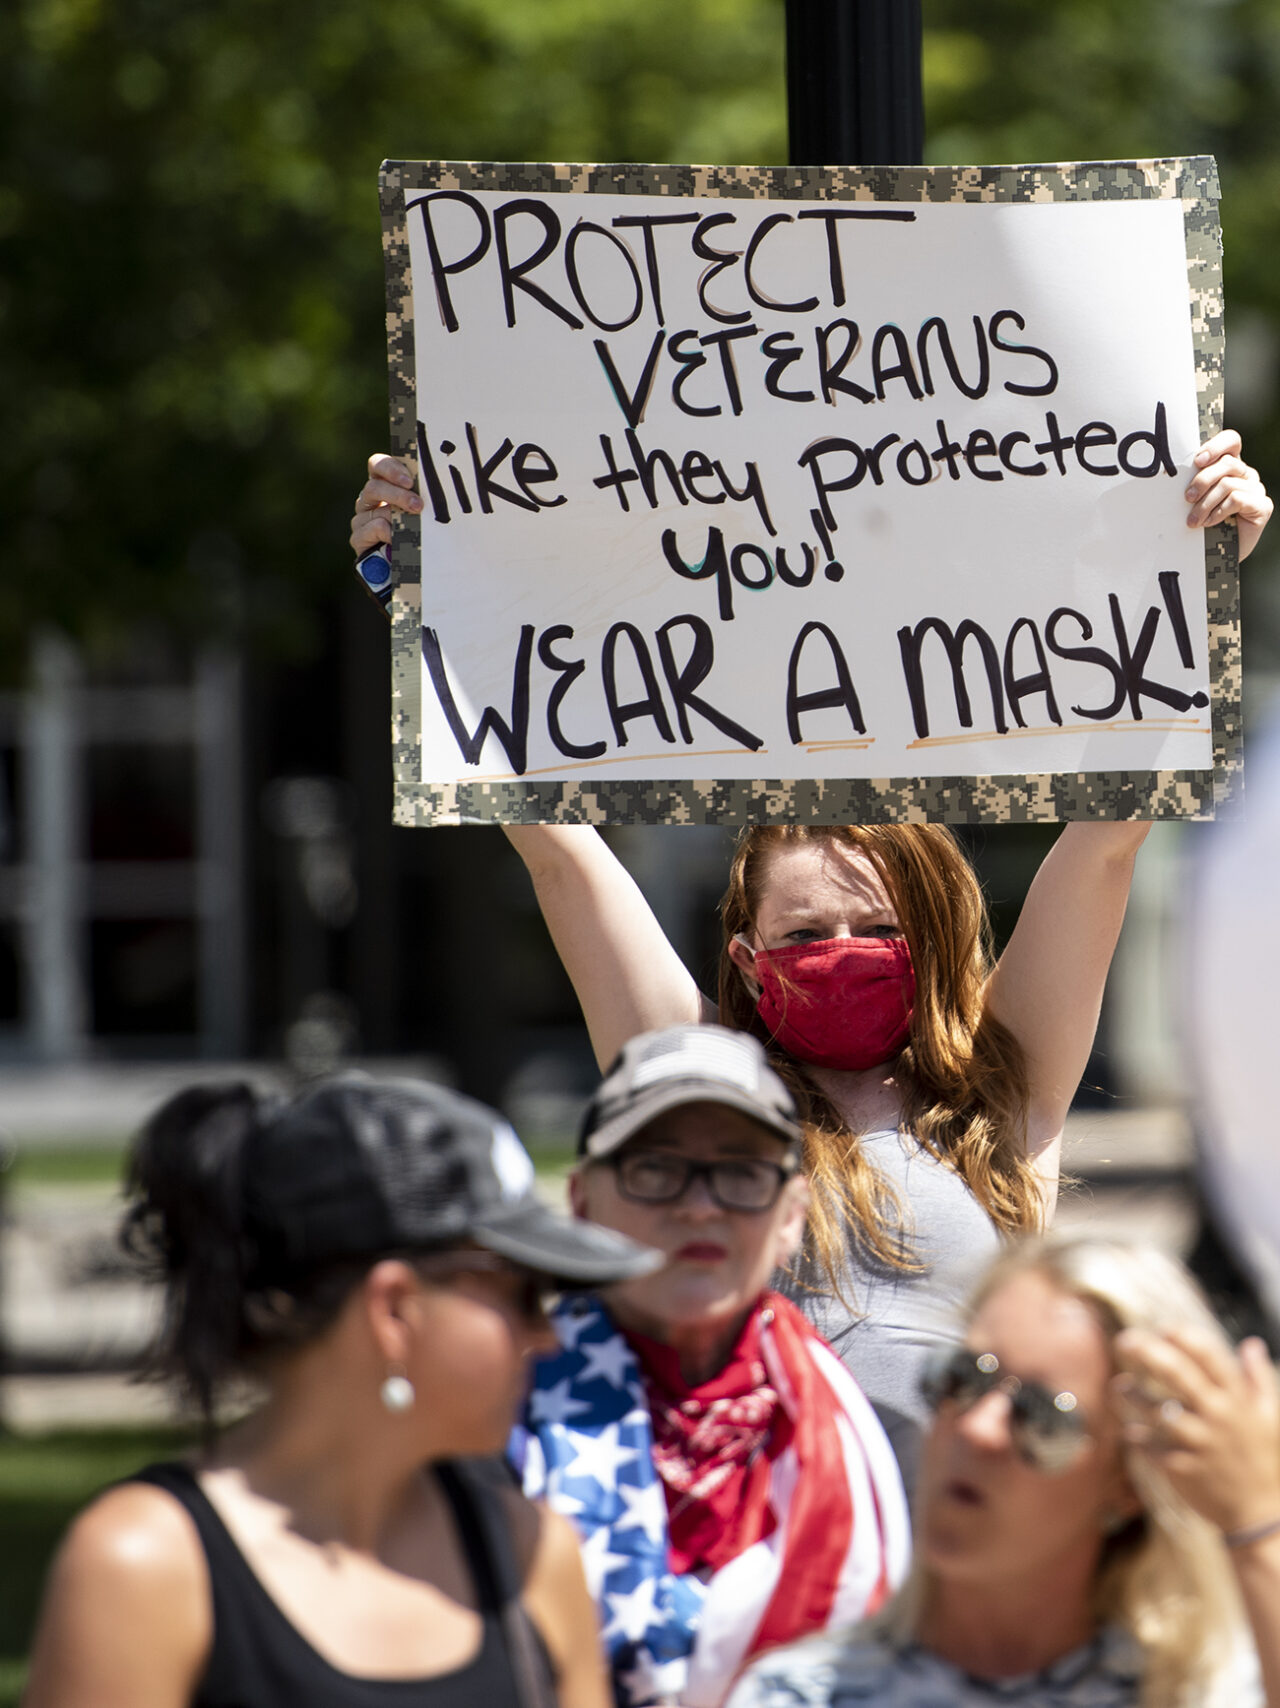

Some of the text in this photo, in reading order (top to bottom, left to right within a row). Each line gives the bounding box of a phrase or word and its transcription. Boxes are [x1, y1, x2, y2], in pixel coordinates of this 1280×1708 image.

[405, 190, 916, 332] PROTECT
[594, 310, 1059, 428] VETERANS
[416, 402, 1178, 536] like they protected
[421, 614, 765, 776] WEAR
[787, 621, 867, 746] A
